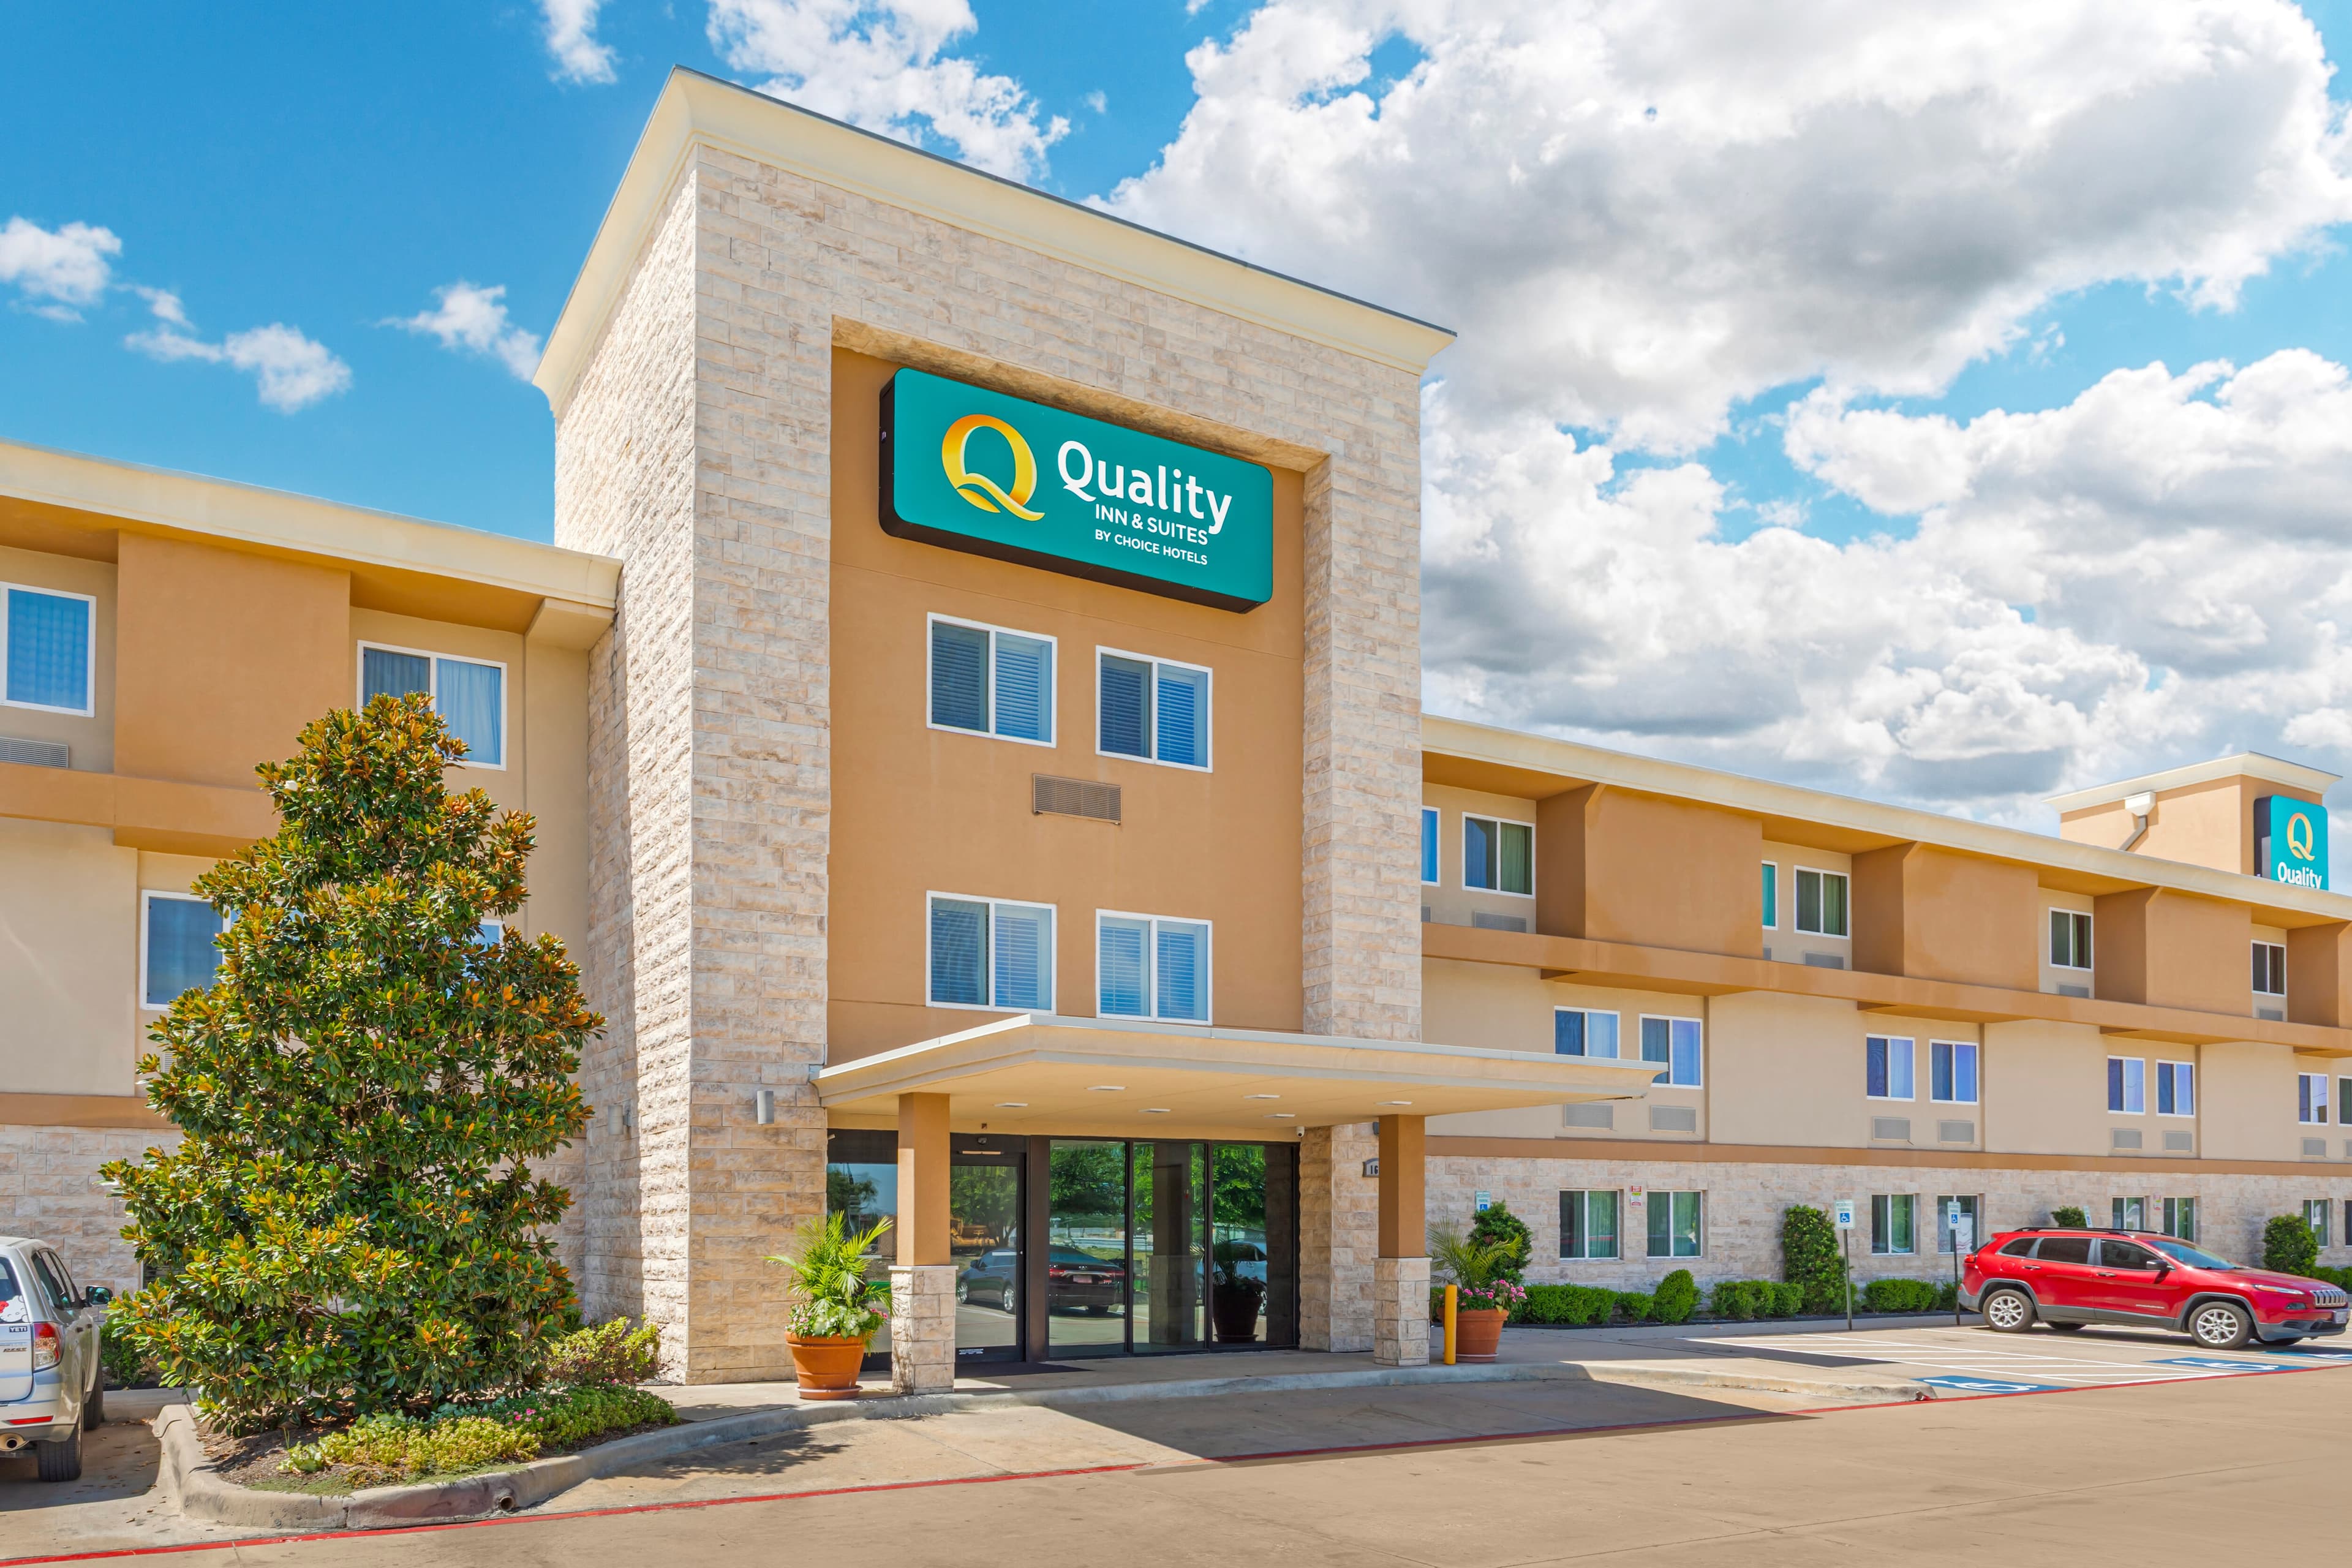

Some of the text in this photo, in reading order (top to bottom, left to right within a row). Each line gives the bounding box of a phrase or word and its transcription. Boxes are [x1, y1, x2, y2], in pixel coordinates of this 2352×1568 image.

[941, 413, 1046, 521] Q
[1058, 440, 1232, 535] Quality
[1095, 503, 1208, 545] INN & SUITES
[1095, 529, 1207, 565] BY CHOICE HOTELS
[2286, 812, 2315, 861] Q
[2277, 861, 2323, 889] Quality
